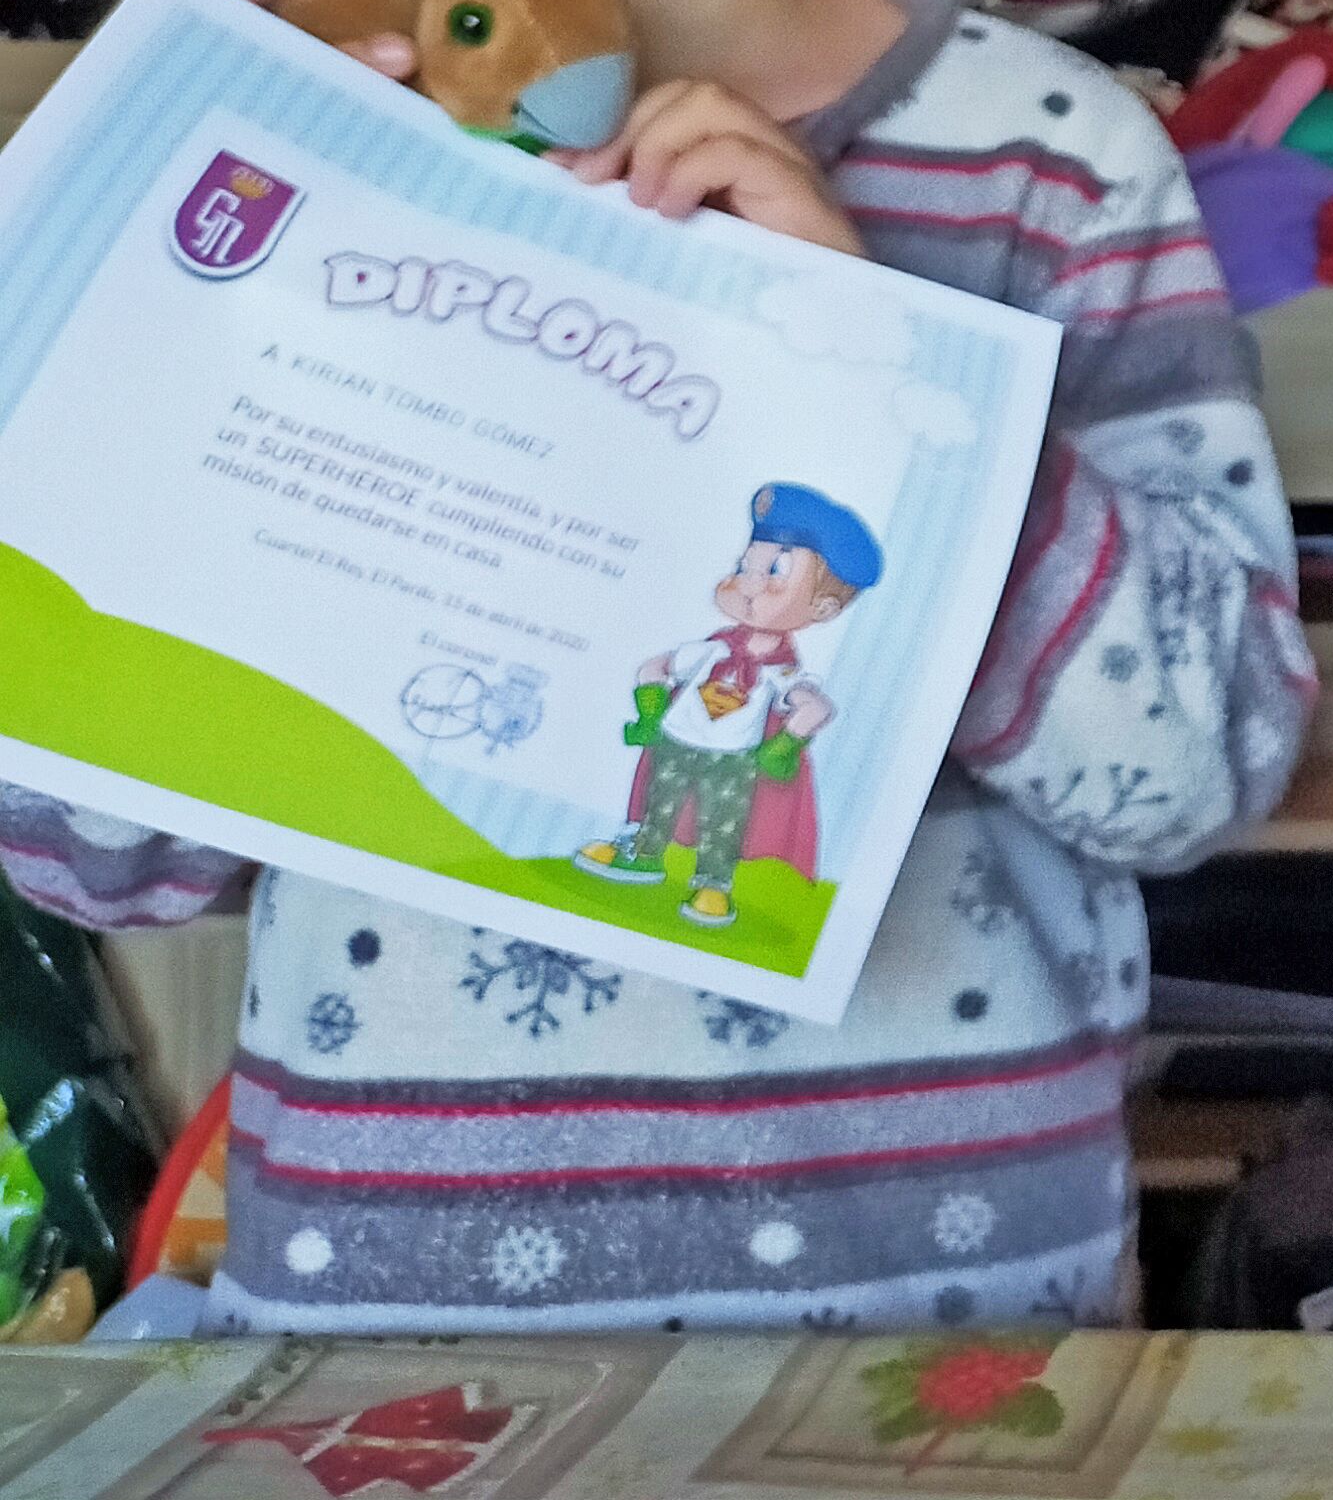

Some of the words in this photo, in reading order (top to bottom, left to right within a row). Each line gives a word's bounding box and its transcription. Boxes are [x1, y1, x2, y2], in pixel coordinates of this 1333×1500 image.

[260, 344, 278, 363] A
[292, 357, 378, 396] KIRIAN
[384, 383, 466, 427] TOMBO
[324, 250, 722, 444] DIPLOMA
[202, 452, 279, 492] misión
[280, 479, 311, 501] de
[313, 493, 419, 540] quedarse
[421, 530, 450, 551] en
[217, 426, 248, 448] un
[427, 498, 555, 554] cumpliendo
[558, 544, 598, 569] con
[600, 560, 627, 579] su
[232, 394, 275, 424] Por
[276, 415, 304, 436] su
[305, 425, 434, 481] entusiasmo
[564, 516, 604, 538] por
[606, 531, 640, 552] ser
